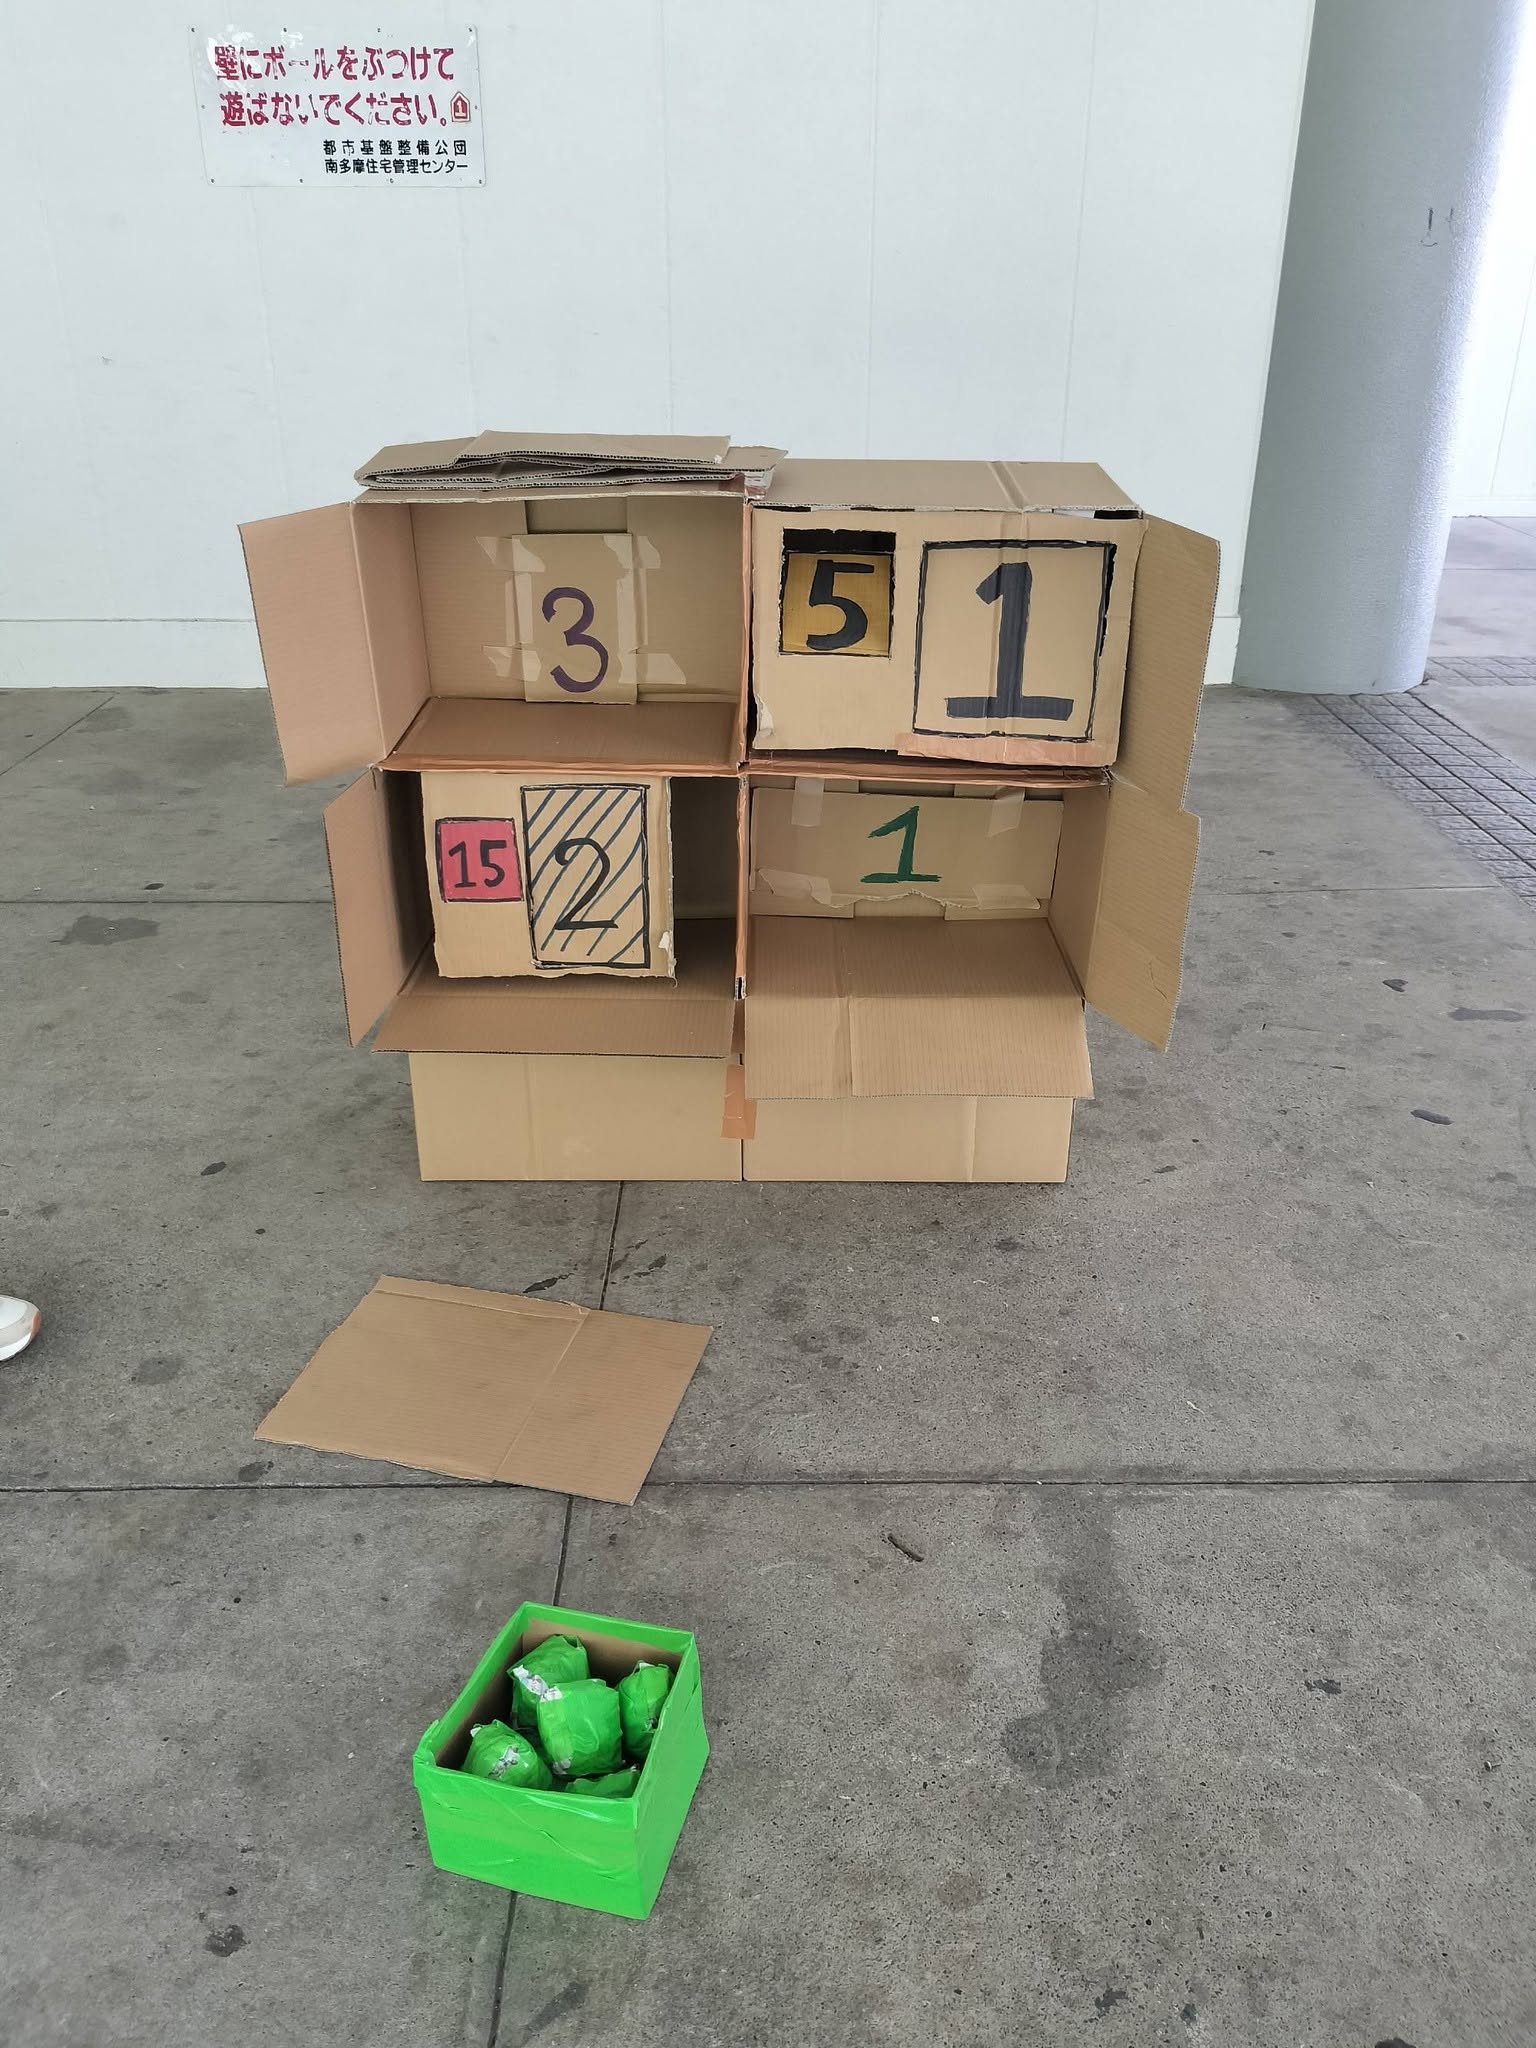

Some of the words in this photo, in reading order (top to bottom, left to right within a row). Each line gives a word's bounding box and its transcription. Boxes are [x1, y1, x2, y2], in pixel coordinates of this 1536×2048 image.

[323, 139, 467, 156] 都市基盤整備公団
[325, 159, 468, 174] 南多摩住宅管理センター
[542, 586, 609, 693] 3
[806, 559, 875, 650] 5
[946, 561, 1074, 721] 1
[448, 839, 507, 888] 15
[554, 837, 619, 930] 2
[861, 805, 942, 883] 1
